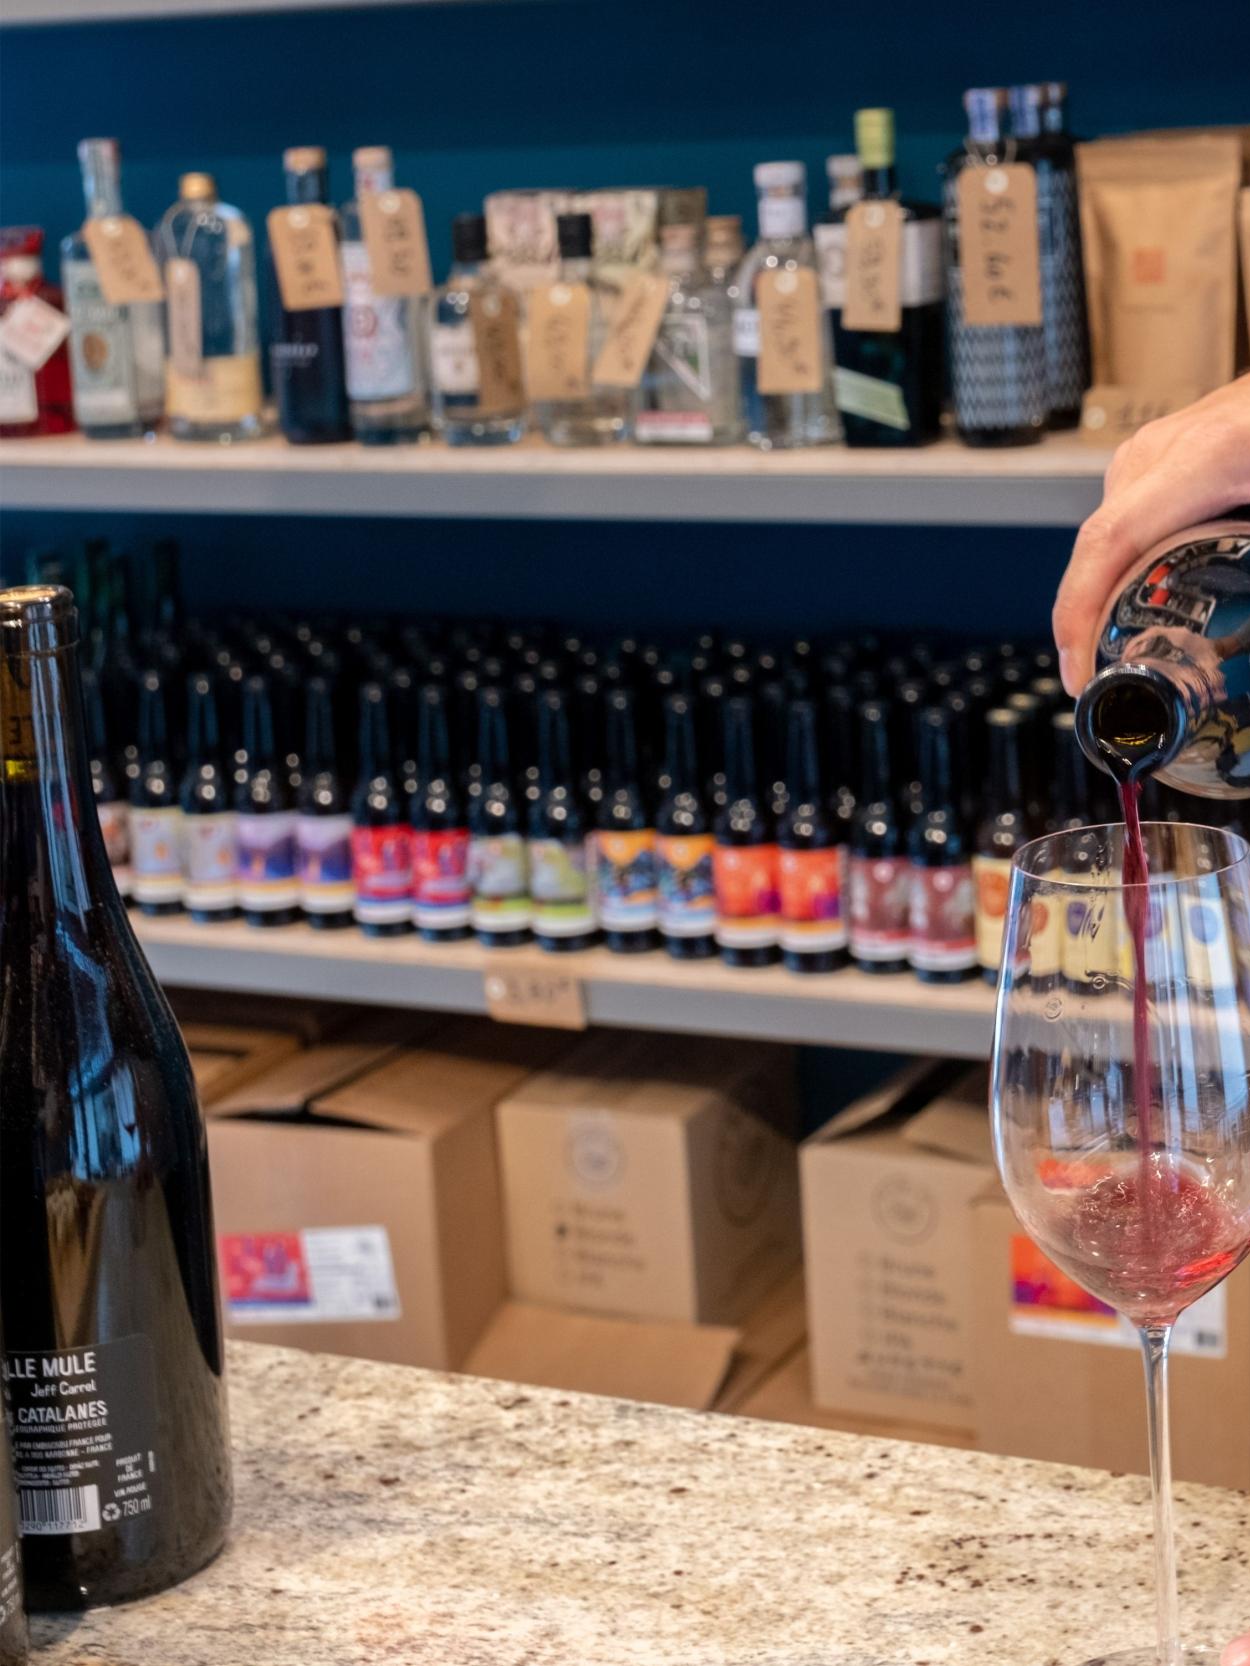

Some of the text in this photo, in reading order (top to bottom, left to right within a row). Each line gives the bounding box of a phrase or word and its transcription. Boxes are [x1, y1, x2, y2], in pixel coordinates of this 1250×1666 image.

[42, 1352, 97, 1378] MULE
[31, 1379, 97, 1398] Jeff Carrel
[18, 1400, 110, 1424] CATALANES
[122, 1494, 152, 1517] 750 ml
